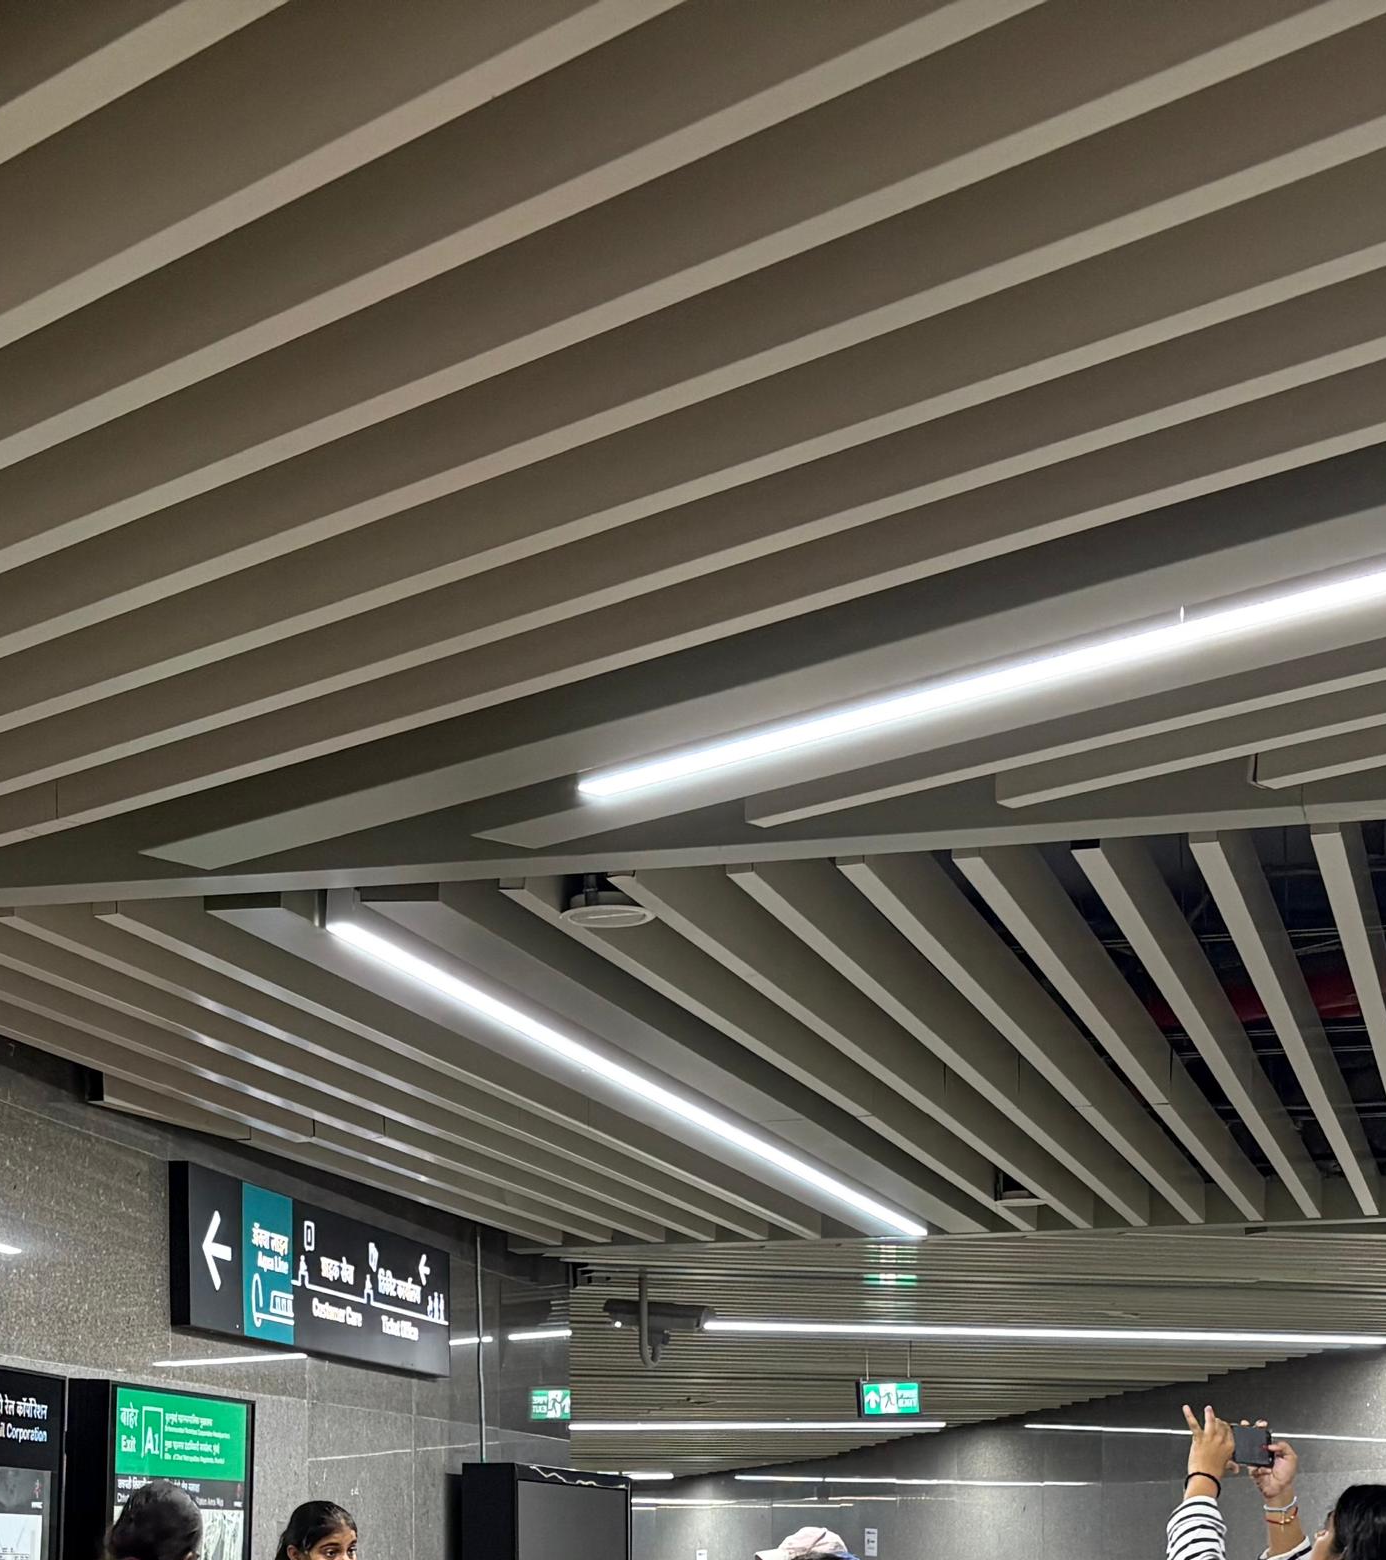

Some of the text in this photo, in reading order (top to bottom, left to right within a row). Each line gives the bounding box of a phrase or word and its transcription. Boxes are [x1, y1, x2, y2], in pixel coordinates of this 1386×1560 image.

[345, 1306, 363, 1328] Care
[6, 1423, 48, 1443] Corporation
[145, 1427, 160, 1454] A1
